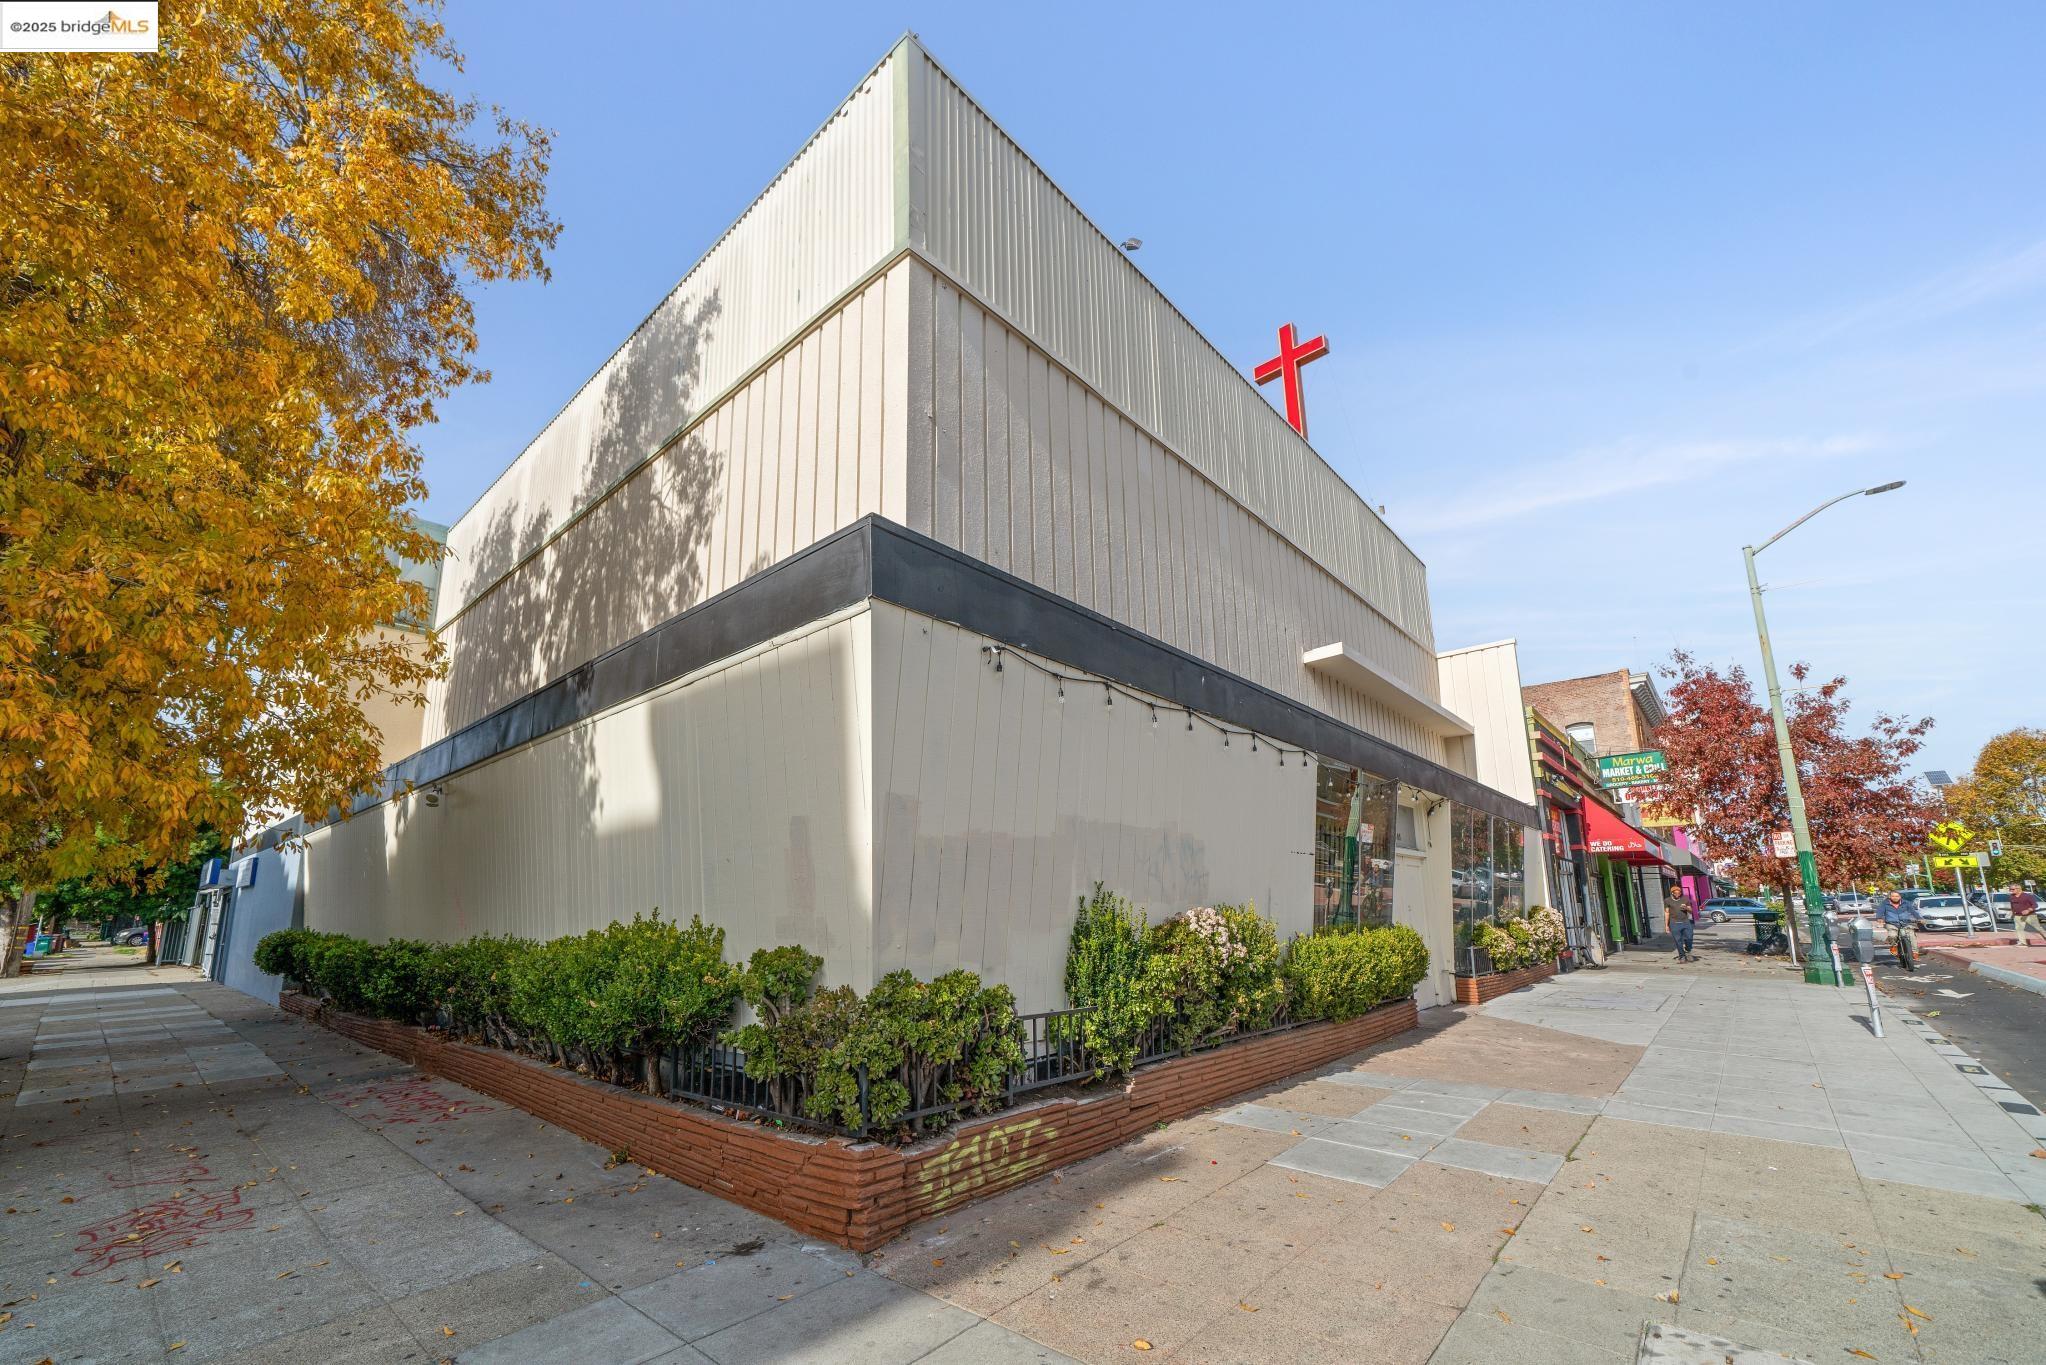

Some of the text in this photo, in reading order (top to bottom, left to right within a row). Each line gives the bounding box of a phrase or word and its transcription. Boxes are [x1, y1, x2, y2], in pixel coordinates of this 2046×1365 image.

[1612, 755, 1653, 767] Marwa
[1602, 766, 1633, 778] MARKET
[1635, 765, 1642, 774] &
